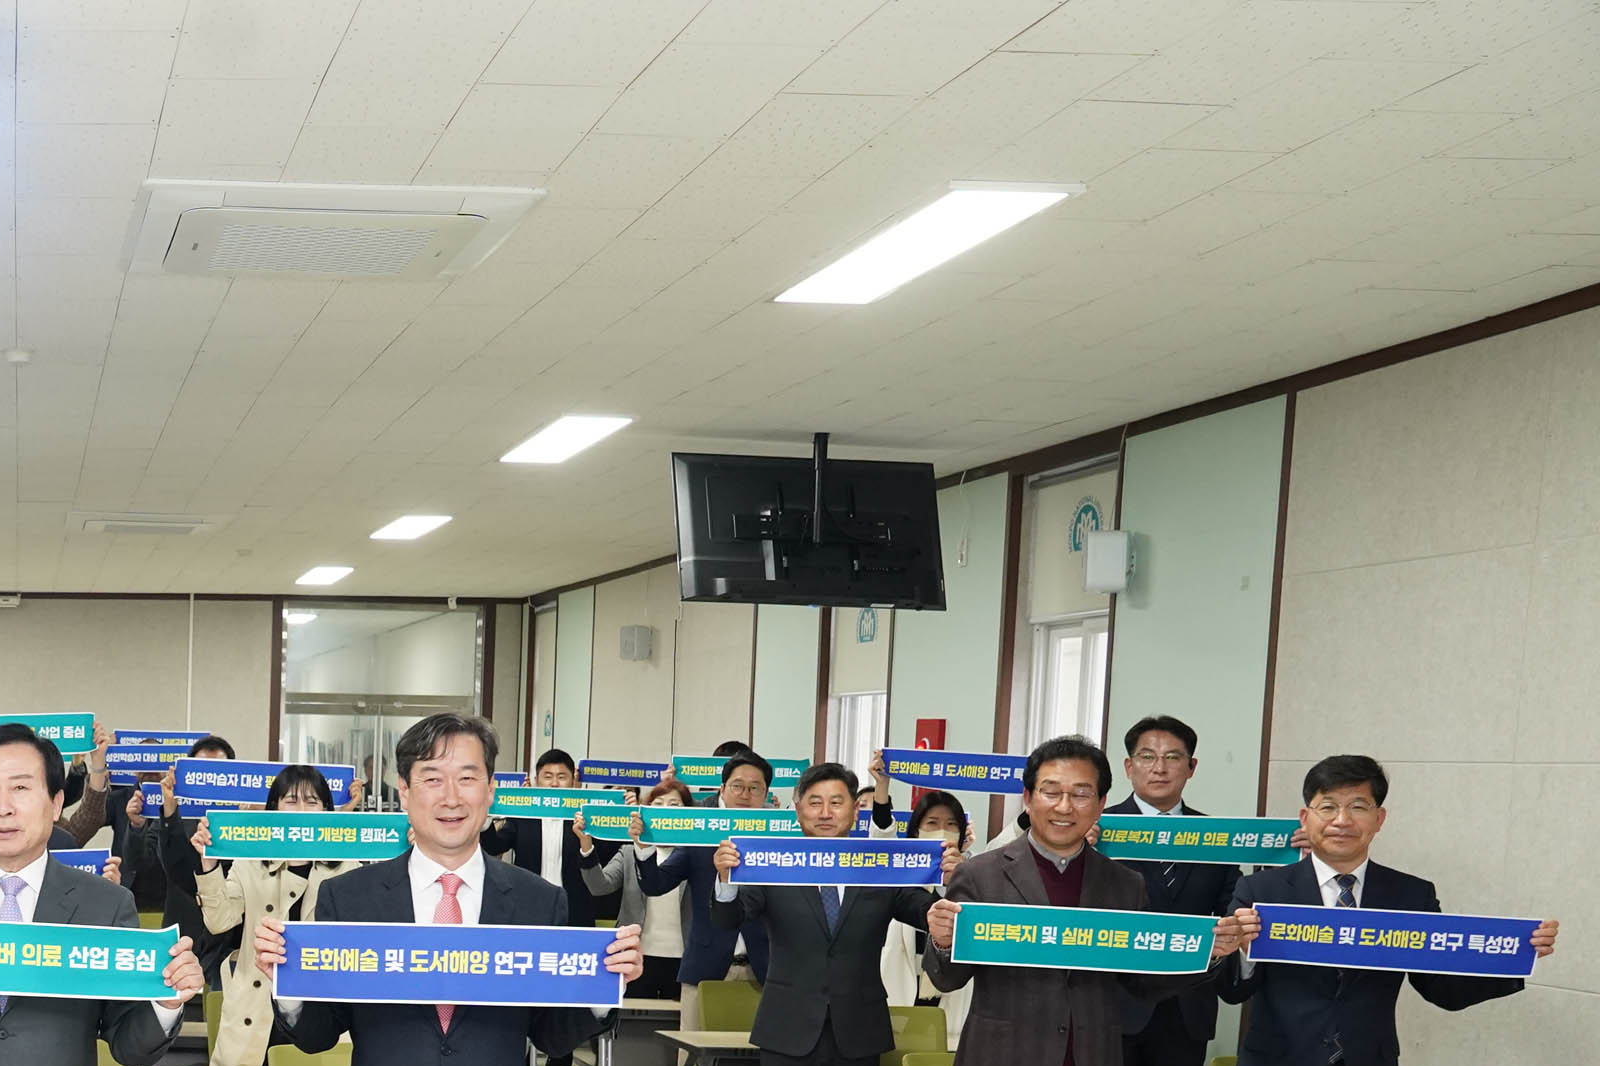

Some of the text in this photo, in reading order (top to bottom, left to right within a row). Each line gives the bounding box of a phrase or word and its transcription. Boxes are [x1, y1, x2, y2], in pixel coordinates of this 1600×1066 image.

[39, 726, 60, 739] 산업
[63, 726, 85, 739] 중심
[143, 753, 158, 762] 대상
[889, 761, 930, 775] 문화예술
[933, 764, 943, 776] 및
[946, 765, 988, 779] 도서해양
[990, 767, 1011, 779] 연구
[185, 771, 239, 787] 성인학습자
[240, 774, 262, 788] 대상
[498, 795, 540, 807] 자연친화적
[542, 797, 560, 807] 주민
[590, 816, 632, 828] 자연친화
[651, 818, 802, 832] 자연친화적 주민 개방형 캠퍼스
[219, 826, 399, 843] 자연친화적 주민 개방형 캠퍼스
[1102, 829, 1288, 848] 의료복지 및 실버 의료 산업 중심
[744, 852, 931, 868] 성인학습자 대상 평생교육 활성화
[974, 923, 1202, 952] 의료복지 및 실버 의료 산업 중심
[1270, 923, 1520, 955] 문화예술 및 도서해양 연구 특성화
[22, 943, 62, 967] 의료
[69, 947, 108, 970] 산업
[115, 948, 156, 972] 중심
[300, 947, 598, 976] 문화예술 및 도서해양 연구 특성화
